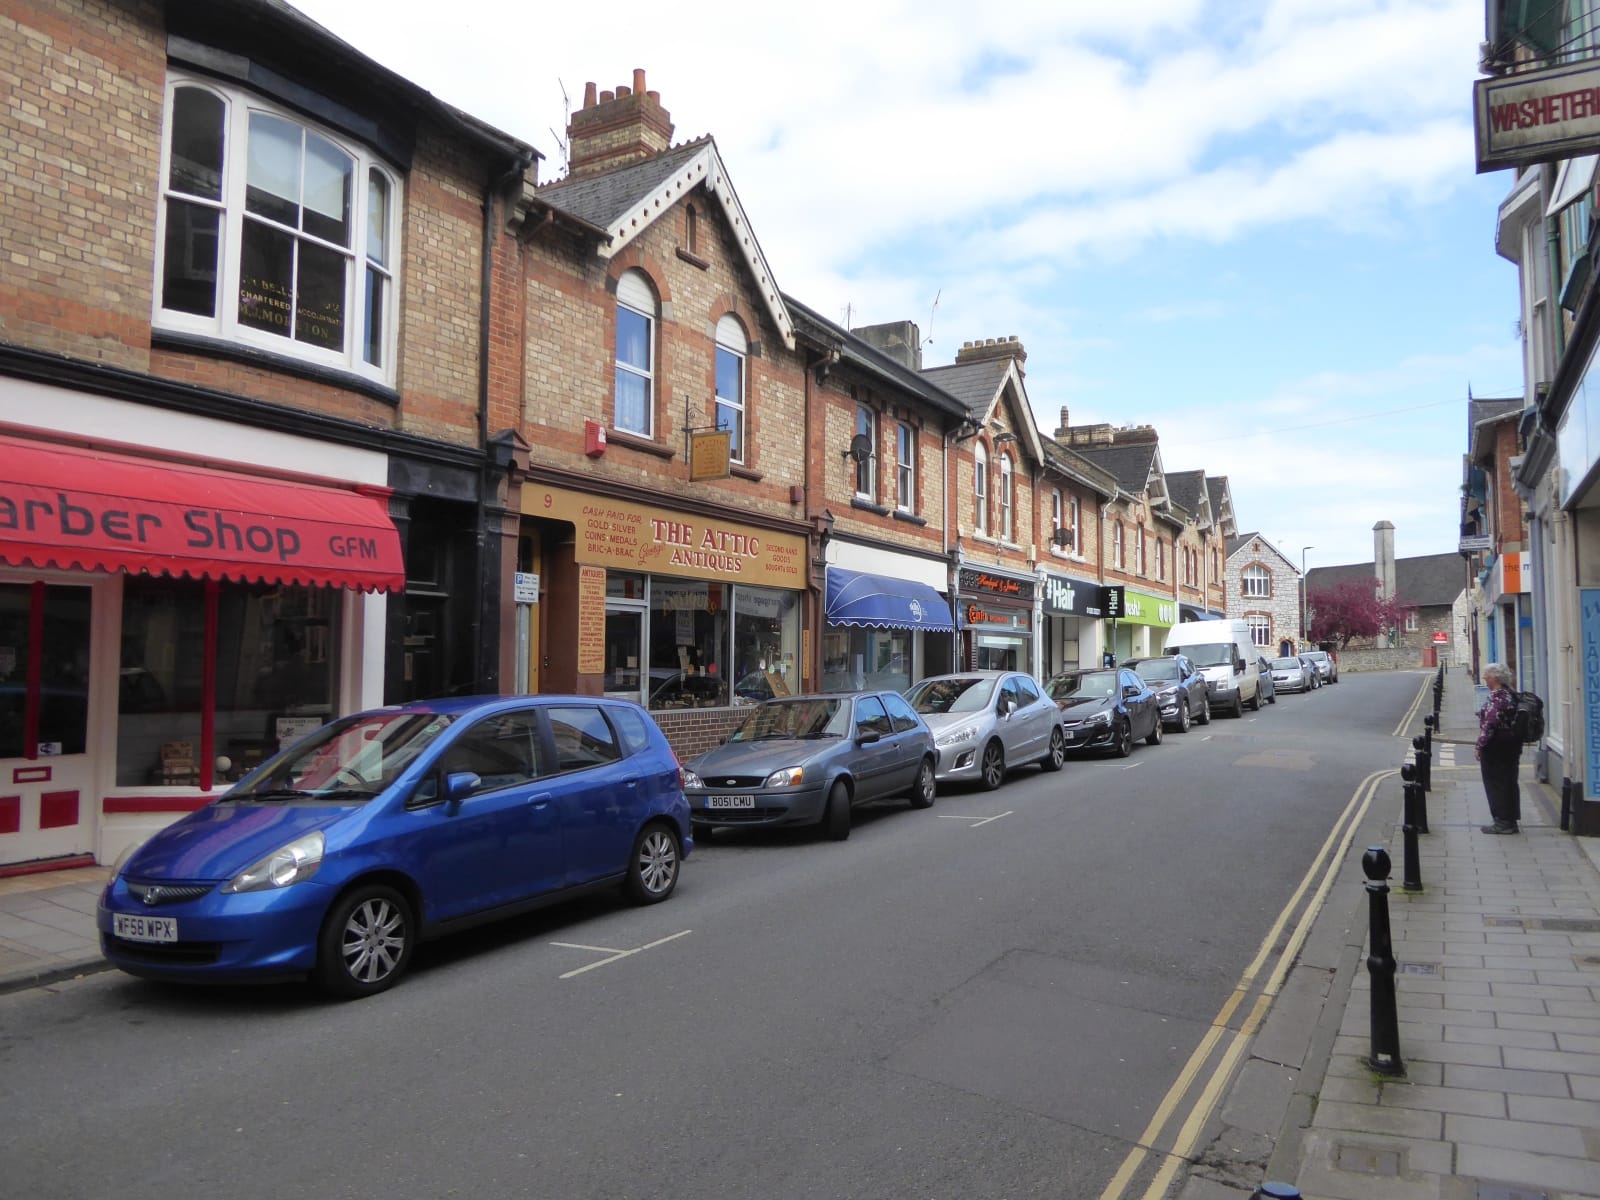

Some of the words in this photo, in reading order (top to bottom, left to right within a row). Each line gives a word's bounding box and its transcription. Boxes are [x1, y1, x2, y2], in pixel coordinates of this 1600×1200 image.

[241, 289, 290, 309] CHARTERED
[544, 494, 552, 508] 9
[582, 506, 604, 517] CASH
[607, 510, 625, 521] PAID
[627, 514, 642, 524] FOR
[588, 519, 608, 530] GOLD
[612, 523, 635, 535] SILVER
[184, 511, 300, 561] Shop
[329, 535, 377, 560] GFM
[585, 530, 606, 542] COINS
[610, 535, 637, 546] MEDALS
[650, 518, 693, 547] THE
[700, 528, 759, 558] ATTIC
[669, 548, 741, 573] ANTIQUES
[1504, 562, 1520, 572] the
[582, 568, 604, 579] ANTIQUES
[734, 796, 751, 807] CMU
[117, 918, 144, 937] WF58
[148, 921, 172, 938] WPX
